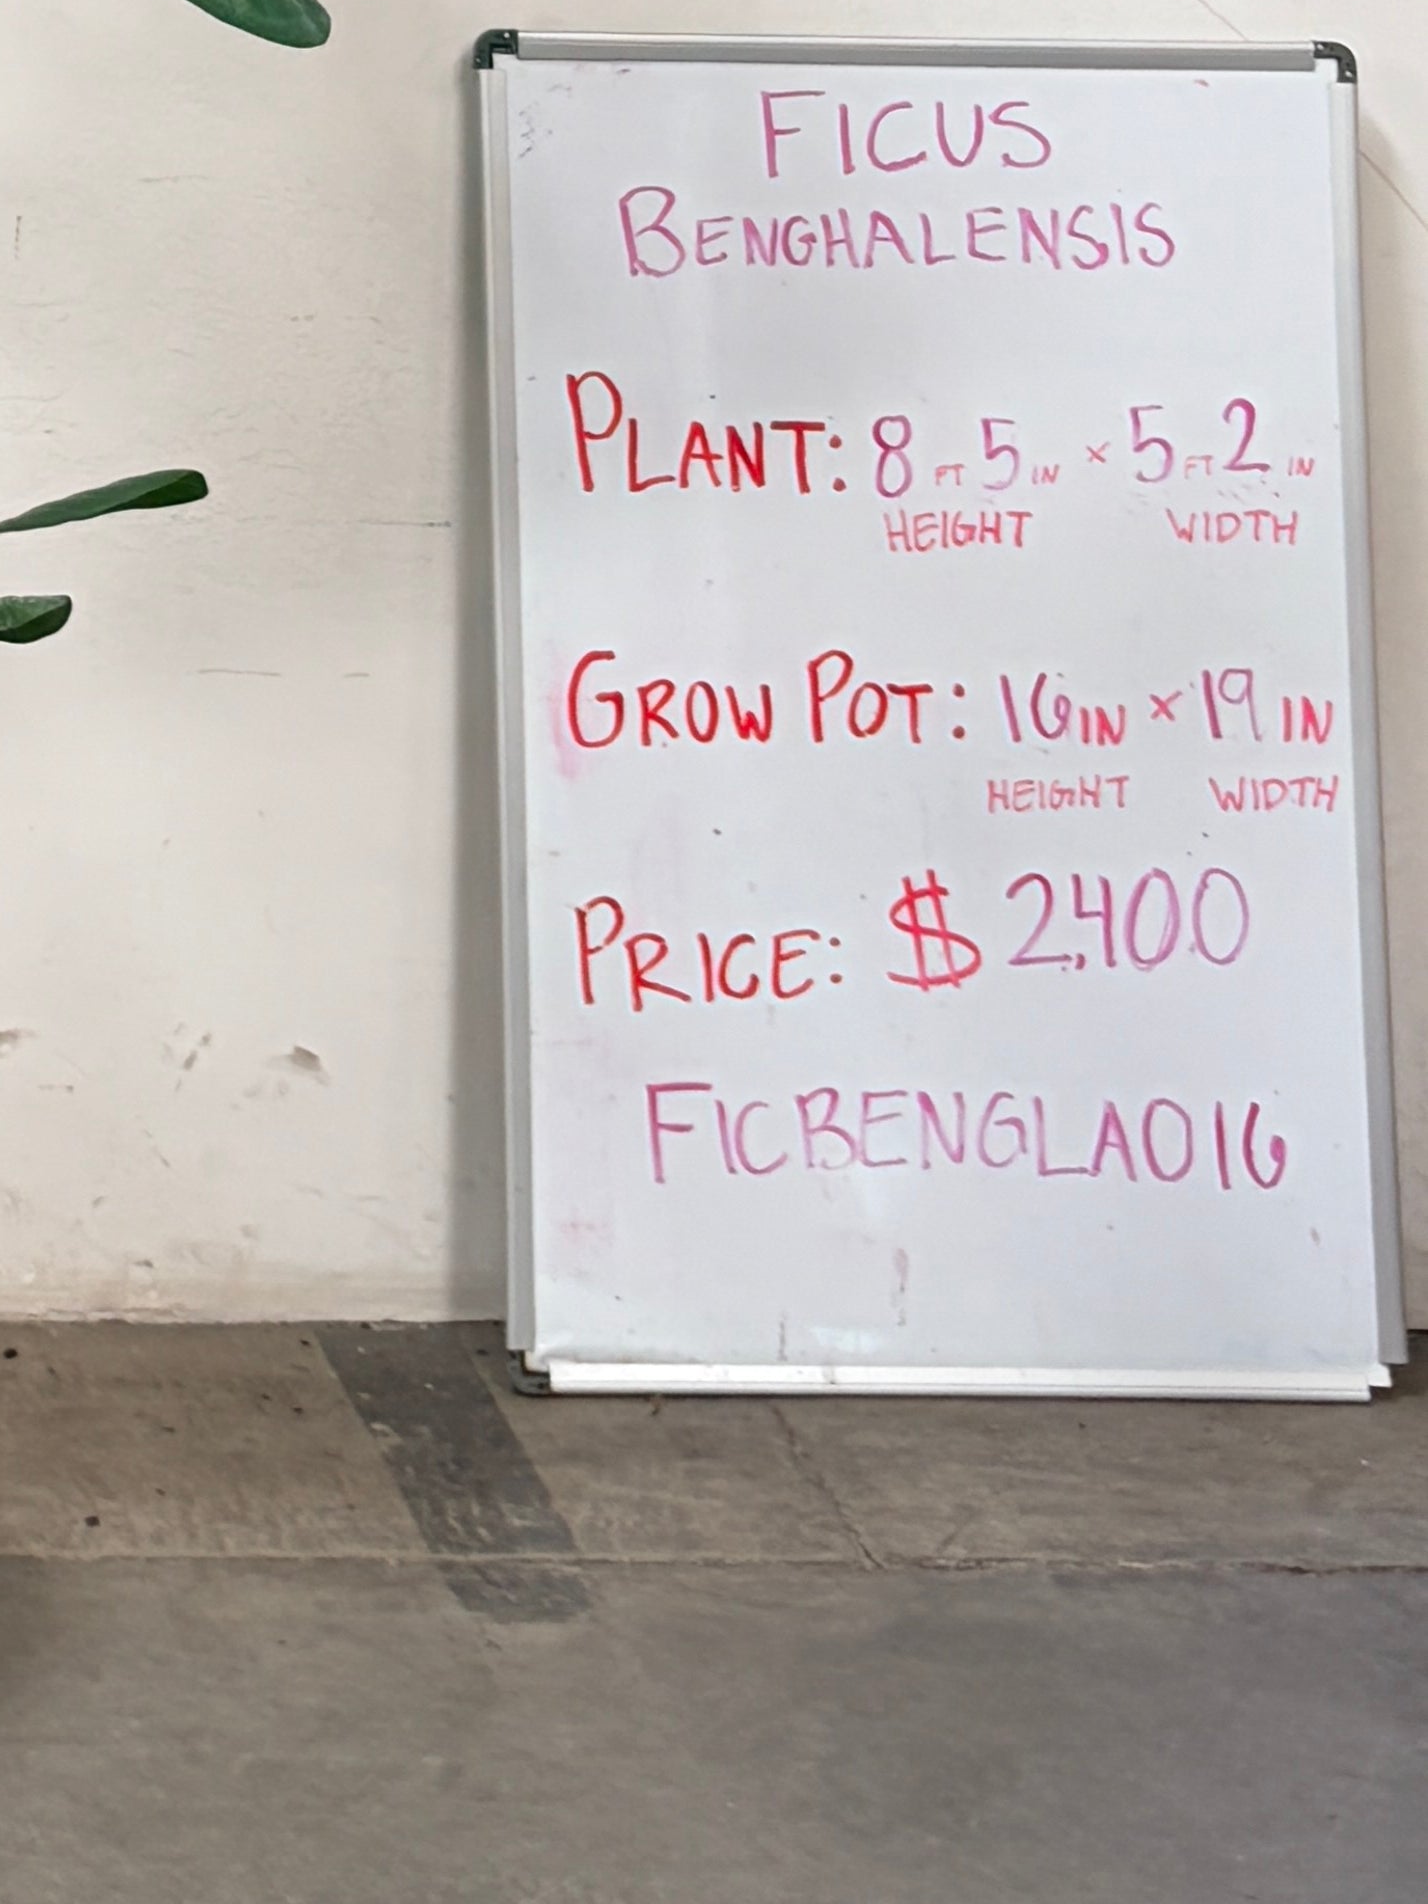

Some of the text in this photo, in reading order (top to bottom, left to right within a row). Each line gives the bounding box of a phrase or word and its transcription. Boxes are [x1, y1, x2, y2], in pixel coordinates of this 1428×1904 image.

[759, 91, 1052, 180] FICUS
[617, 186, 1177, 280] BENGHALENSIS
[563, 370, 848, 497] PLANT:
[870, 415, 913, 501] 8
[934, 462, 964, 488] FT
[979, 416, 1021, 492] 5
[1030, 463, 1060, 485] IN
[1127, 406, 1176, 484] 5
[1184, 454, 1213, 474] FT
[1221, 396, 1270, 475] 2
[1287, 455, 1315, 478] IN
[887, 509, 1298, 553] HEIGHT WIDTH
[565, 649, 773, 748] GROW
[804, 648, 967, 746] POT:
[1200, 668, 1261, 742] 19
[1281, 696, 1333, 745] IN
[987, 775, 1339, 813] HEIGHT WIDTH
[573, 895, 843, 1014] PRICE:
[644, 1081, 1289, 1191] FICBENGLA016
